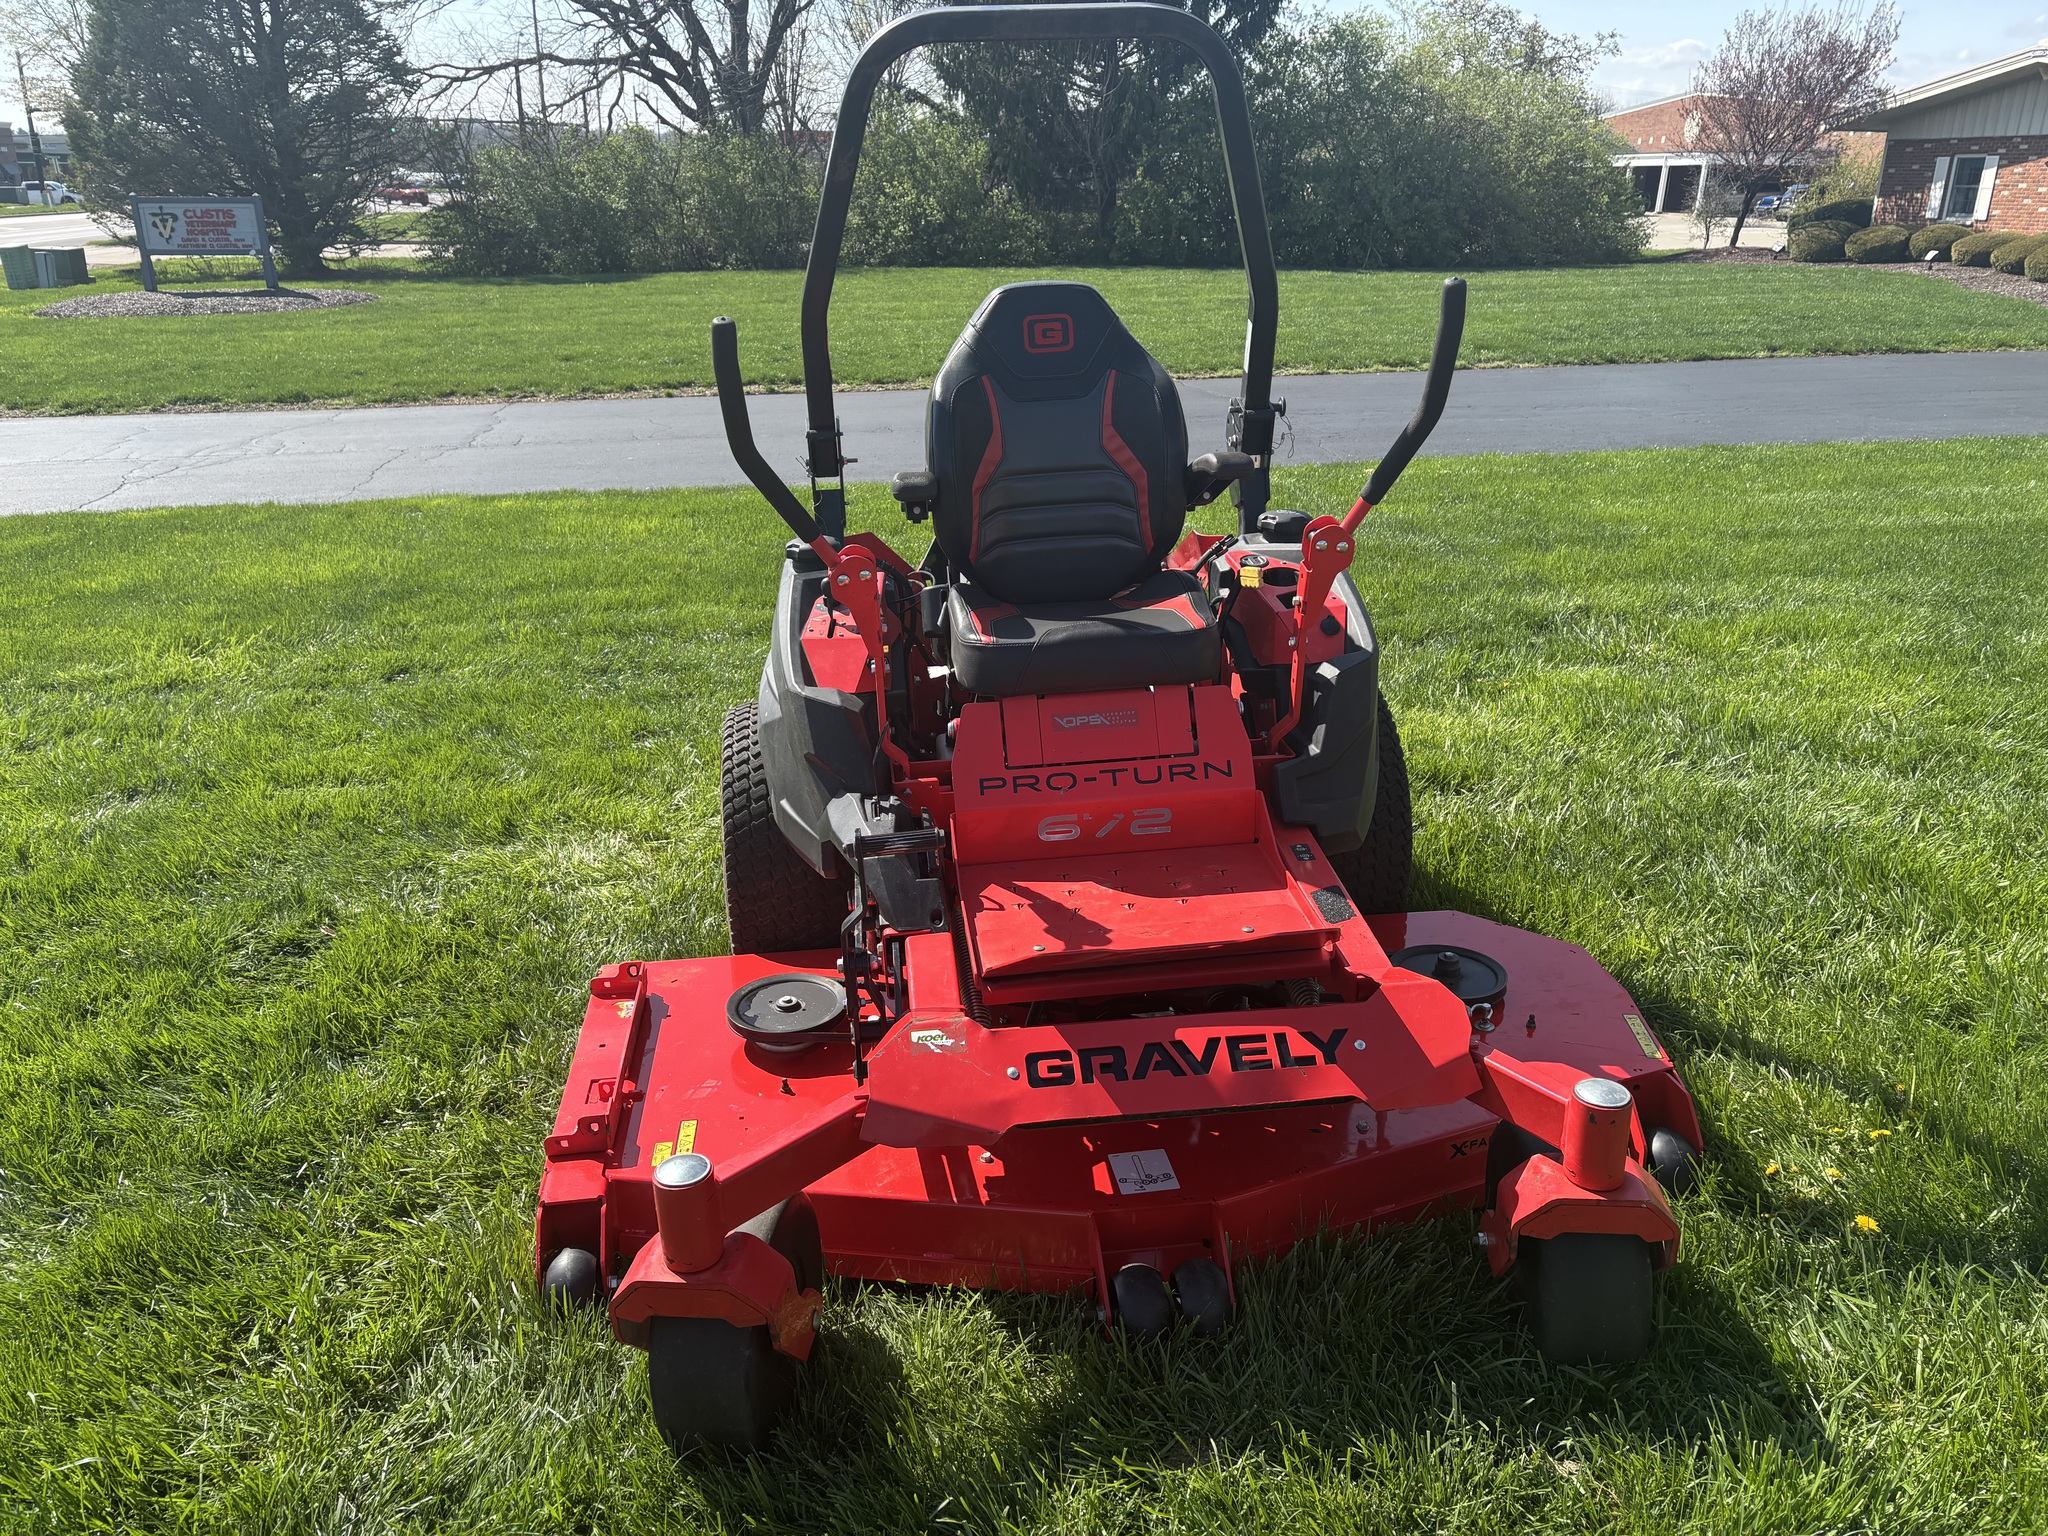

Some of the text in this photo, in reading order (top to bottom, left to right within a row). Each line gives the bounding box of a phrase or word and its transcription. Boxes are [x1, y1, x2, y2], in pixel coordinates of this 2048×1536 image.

[183, 208, 236, 219] CUSTIS
[184, 220, 237, 228] VETERINARY
[186, 228, 231, 236] HOSPITAL
[1034, 322, 1063, 345] G
[979, 760, 1233, 796] PRO-TURN
[1025, 1028, 1349, 1088] GRAVELY
[1450, 1138, 1487, 1160] X-FA
